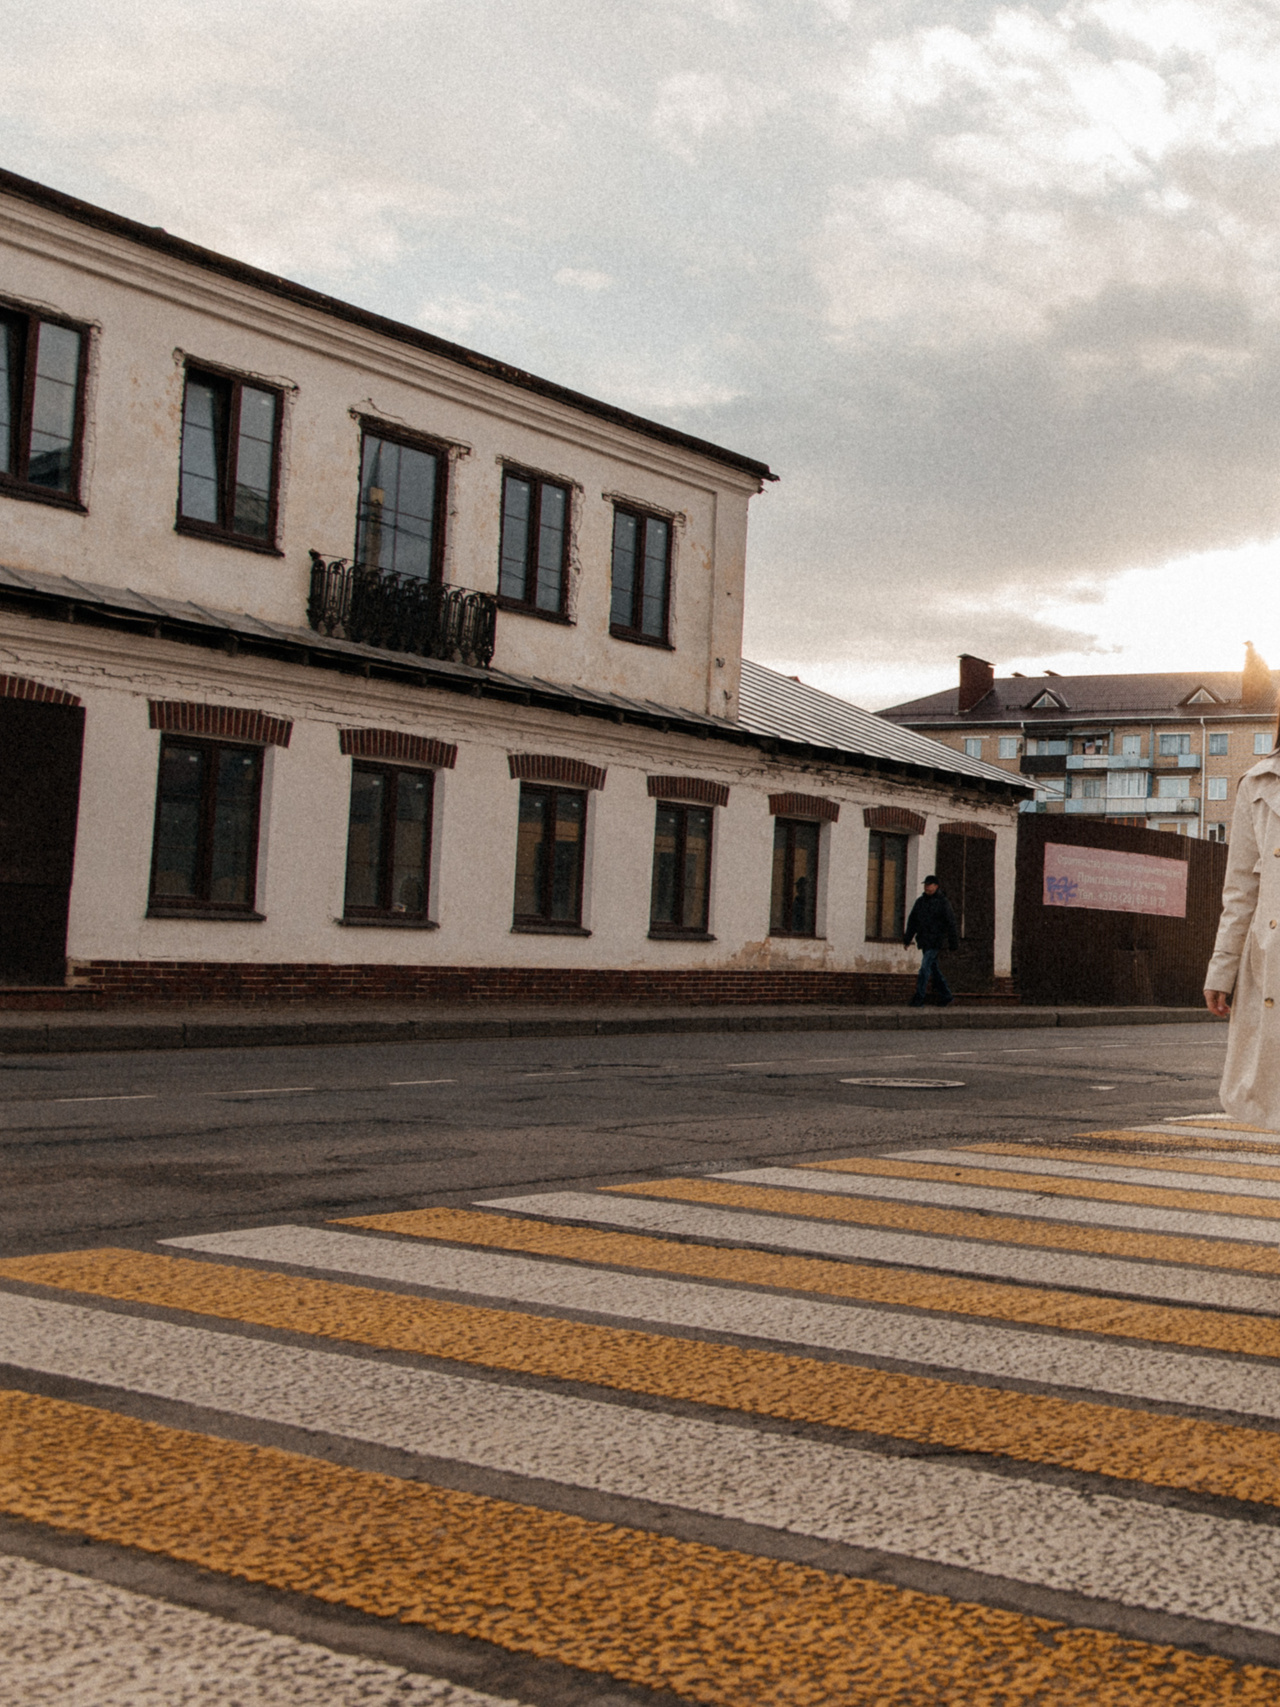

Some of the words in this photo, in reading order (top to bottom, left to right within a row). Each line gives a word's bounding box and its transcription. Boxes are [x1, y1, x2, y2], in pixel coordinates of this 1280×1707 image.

[1077, 871, 1130, 888] Приглашаем
[1077, 888, 1096, 900] Тел.
[1098, 890, 1117, 902] +375
